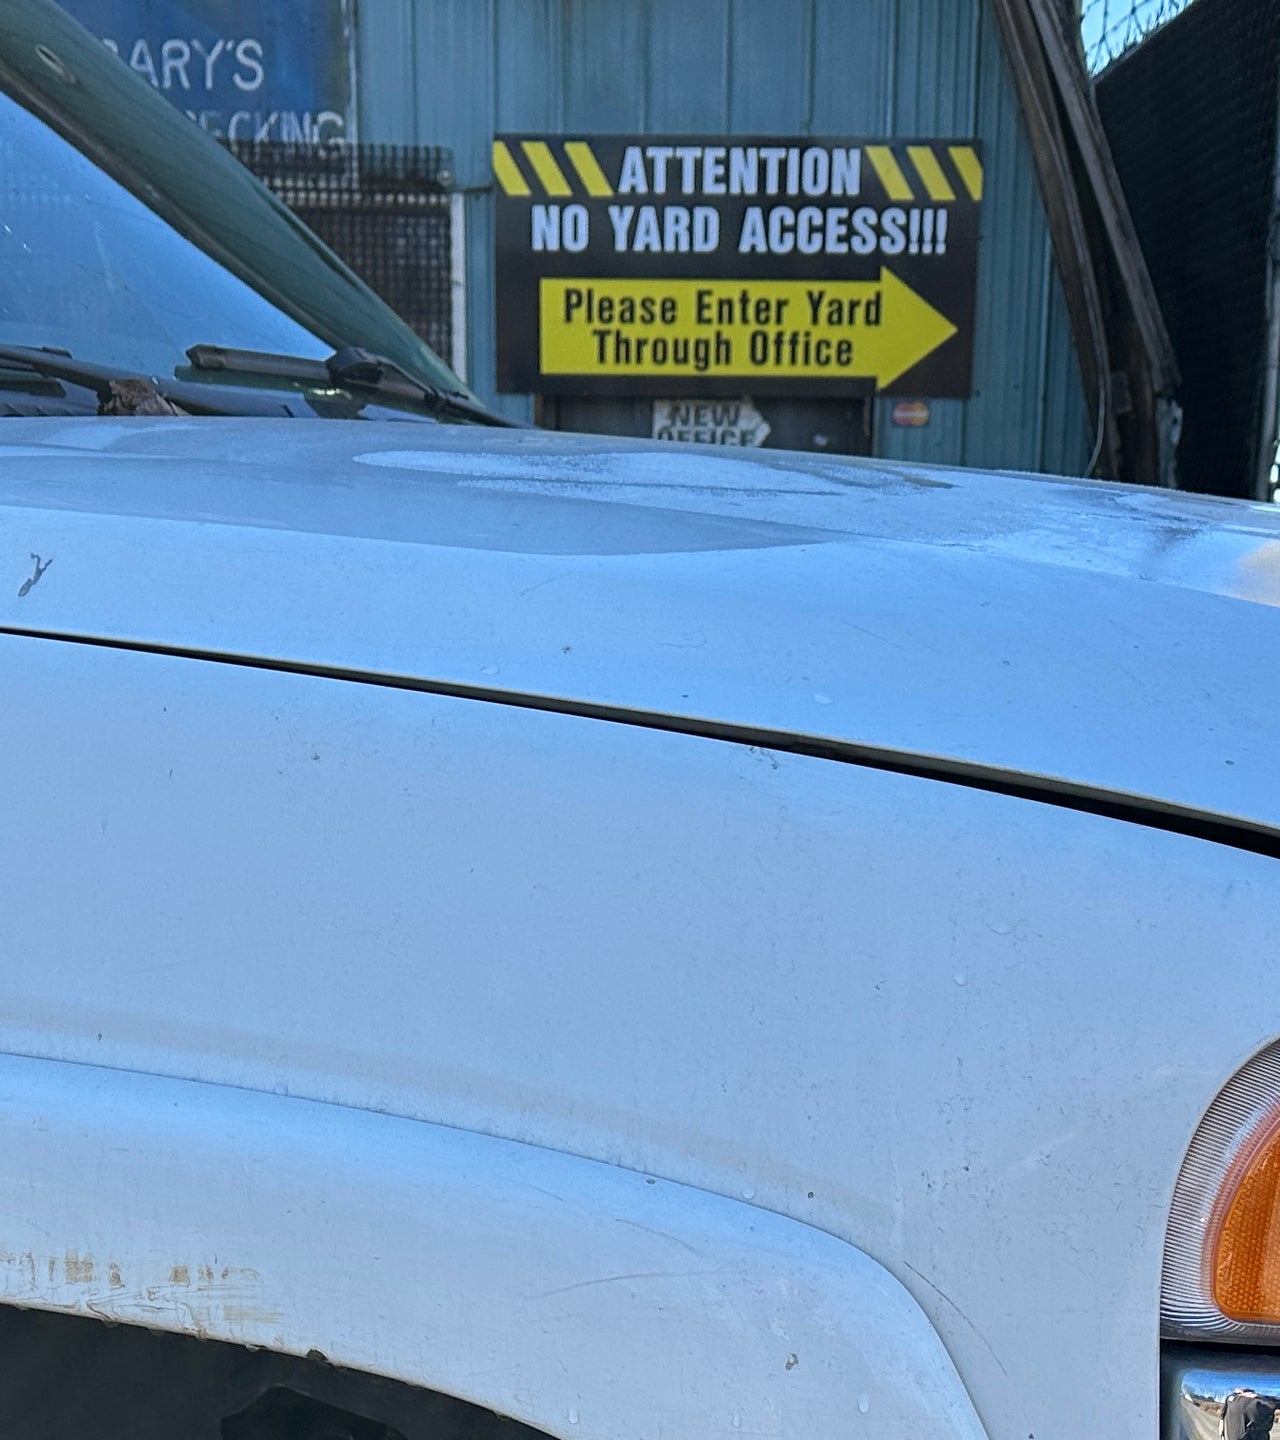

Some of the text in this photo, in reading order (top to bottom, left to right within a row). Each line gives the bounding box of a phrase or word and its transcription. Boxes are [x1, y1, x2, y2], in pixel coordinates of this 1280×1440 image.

[103, 37, 265, 92] ARY'S
[619, 145, 861, 195] ATTENTION
[530, 204, 949, 255] NO YARD ACCESS!!!
[563, 287, 882, 328] Please Enter Yard
[592, 329, 854, 372] Through Office
[669, 403, 741, 428] NEW
